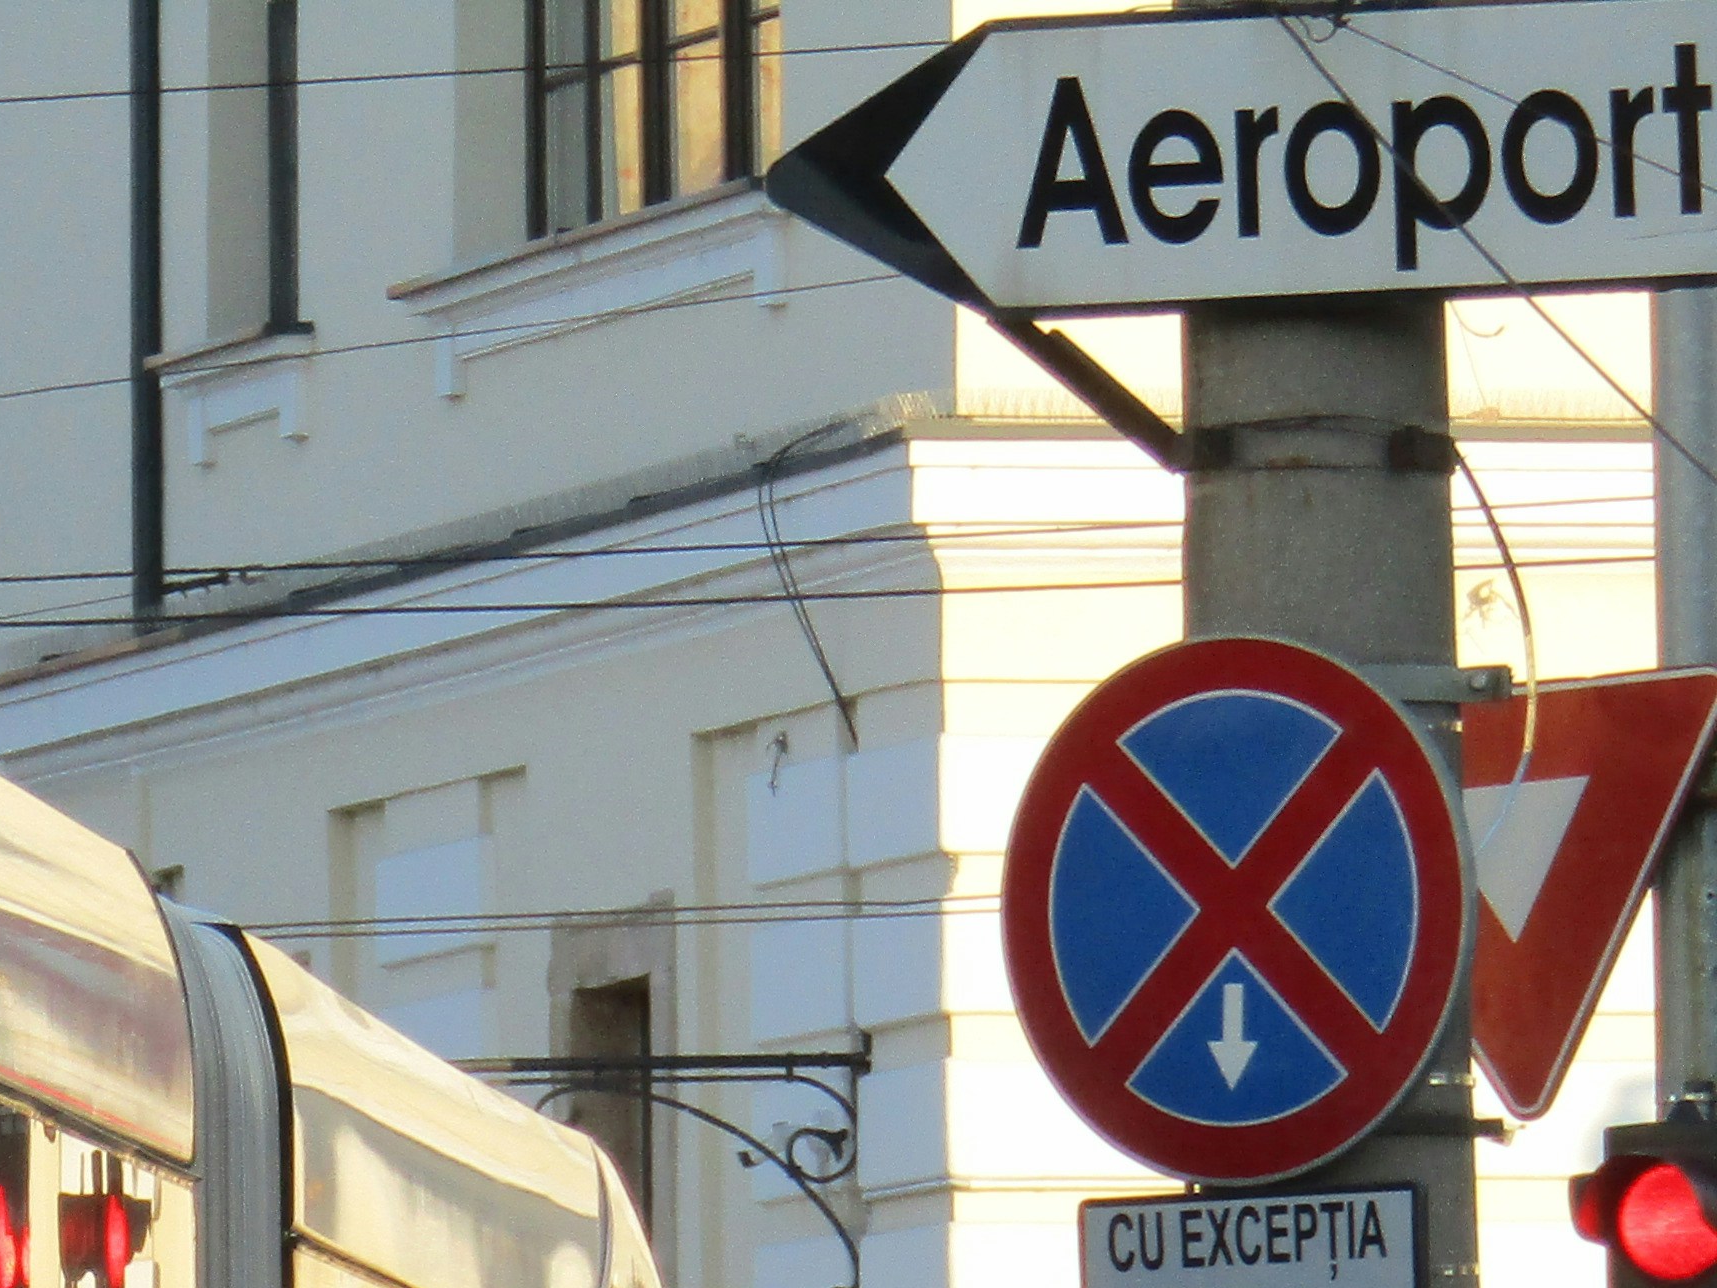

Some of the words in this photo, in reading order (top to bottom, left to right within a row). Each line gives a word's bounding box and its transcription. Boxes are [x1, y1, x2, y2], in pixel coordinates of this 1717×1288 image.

[1016, 43, 1713, 271] Aeroport
[1107, 1210, 1165, 1273] CU
[1179, 1200, 1388, 1281] EXCEPȚIA
